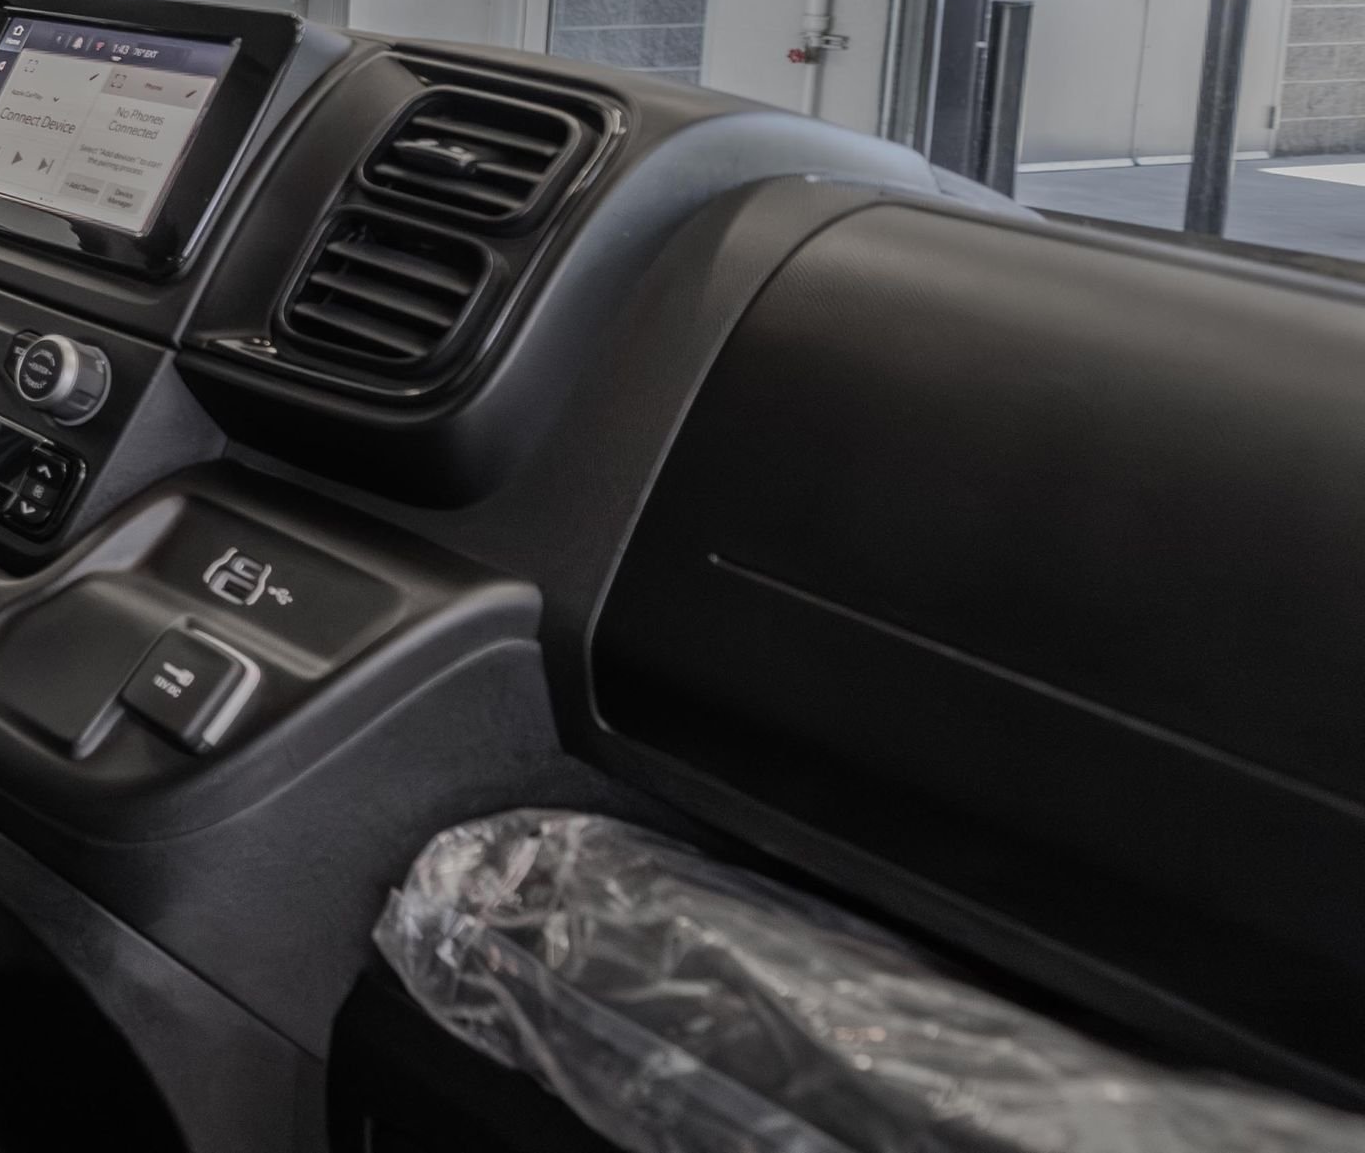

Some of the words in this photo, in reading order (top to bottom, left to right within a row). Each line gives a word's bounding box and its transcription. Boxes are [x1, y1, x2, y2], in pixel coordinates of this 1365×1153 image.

[112, 43, 129, 57] 1:43
[0, 107, 41, 128] Connect
[41, 116, 76, 134] Device
[116, 106, 130, 118] No
[130, 109, 166, 125] Phones
[108, 120, 159, 140] Connected
